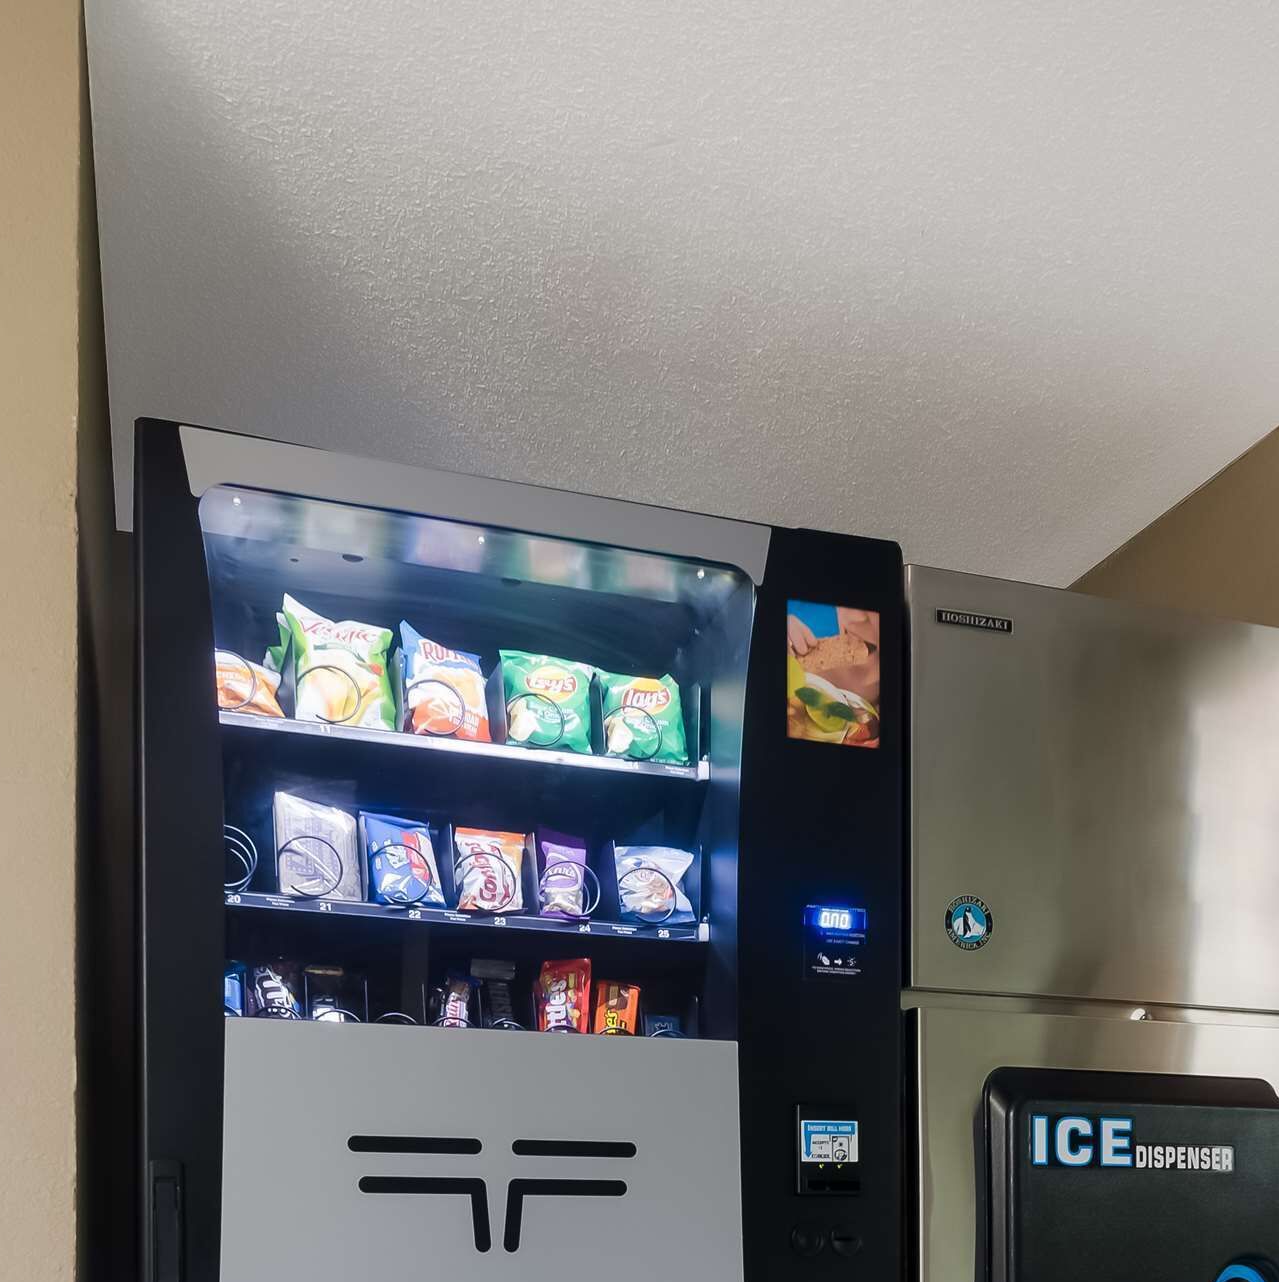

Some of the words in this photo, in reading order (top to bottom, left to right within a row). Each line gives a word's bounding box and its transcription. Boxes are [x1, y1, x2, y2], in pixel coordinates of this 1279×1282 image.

[941, 611, 1009, 630] HOSHIZAKI
[227, 894, 242, 904] 20
[319, 902, 332, 911] 21
[408, 909, 421, 919] 22
[494, 917, 507, 926] 23
[579, 924, 591, 933] 24
[657, 929, 670, 938] 25
[543, 979, 568, 1031] ttles
[1032, 1115, 1133, 1167] ICE
[1135, 1145, 1233, 1172] DISPENSER
